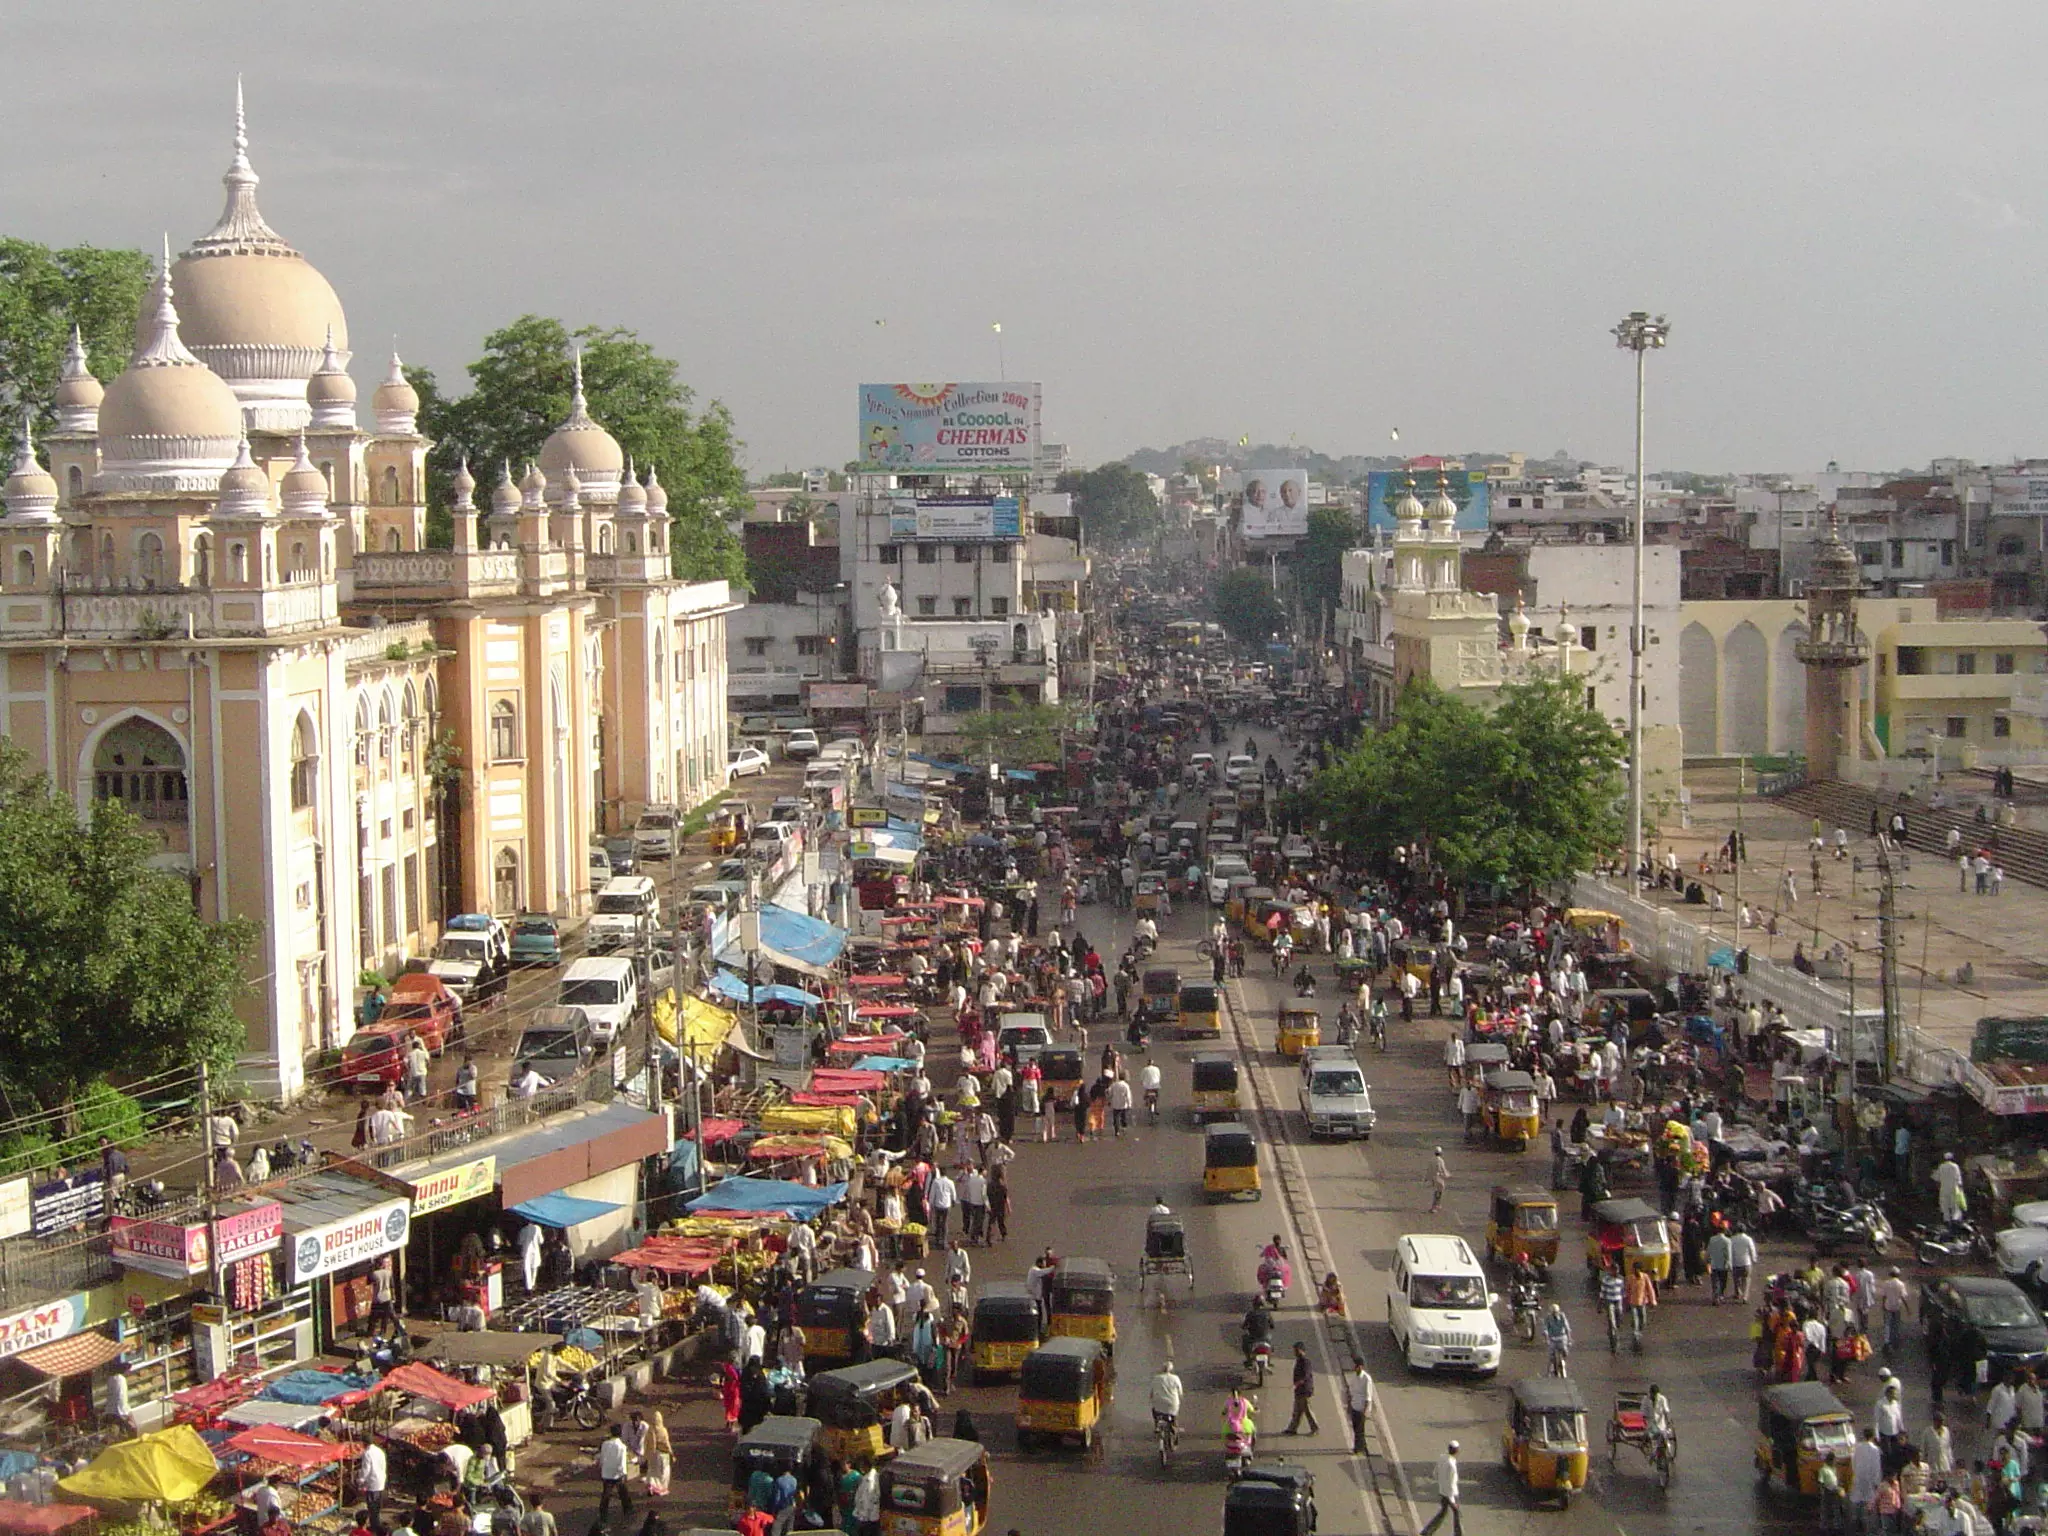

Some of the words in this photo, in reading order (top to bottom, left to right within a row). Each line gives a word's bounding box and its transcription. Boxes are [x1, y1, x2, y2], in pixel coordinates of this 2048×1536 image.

[900, 404, 941, 419] Summer
[944, 389, 999, 413] Collection
[957, 447, 1010, 457] COTTONS
[428, 1193, 453, 1209] SHOP
[219, 1226, 275, 1252] BAKERY
[324, 1215, 383, 1252] ROSHAN
[133, 1240, 181, 1258] BAKERY
[323, 1246, 354, 1268] SWEET
[357, 1235, 385, 1255] HOUSE
